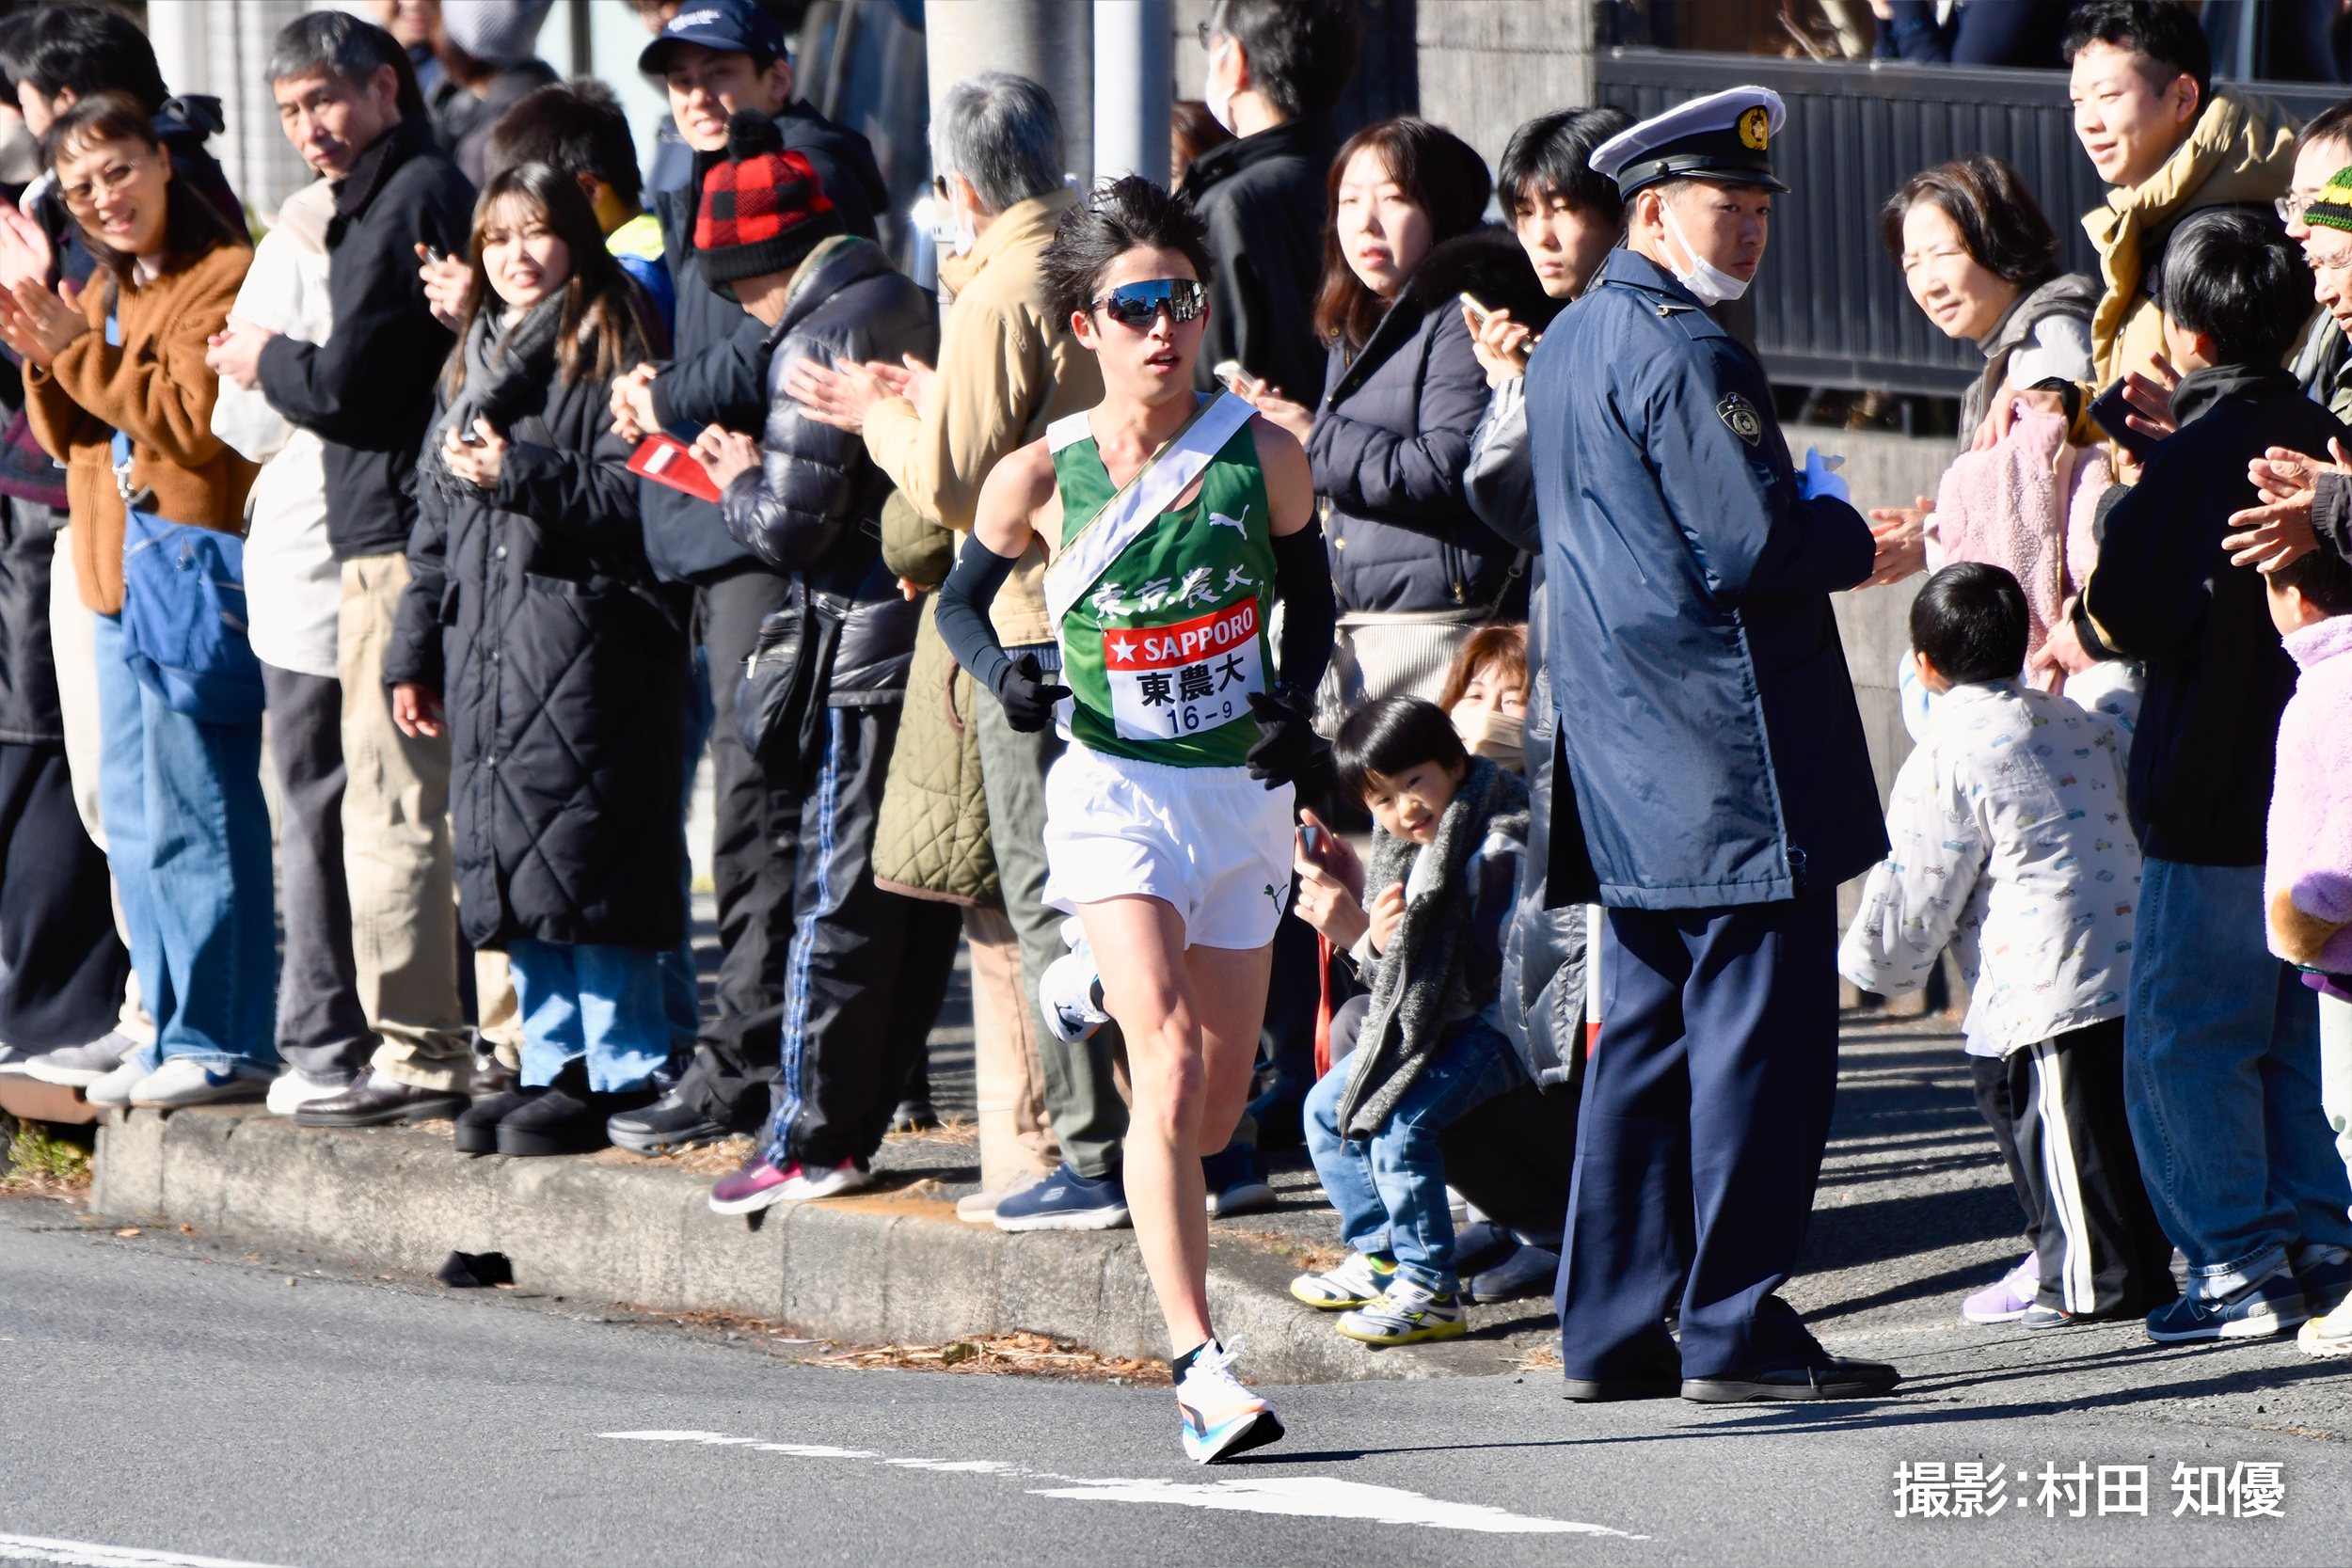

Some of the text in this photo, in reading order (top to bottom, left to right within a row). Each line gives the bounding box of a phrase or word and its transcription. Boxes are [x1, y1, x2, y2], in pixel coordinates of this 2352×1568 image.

[1091, 563, 1253, 621] 東京農大
[1143, 607, 1253, 662] SAPPORO
[1136, 653, 1247, 706] 東農大
[1167, 701, 1232, 735] 16-9
